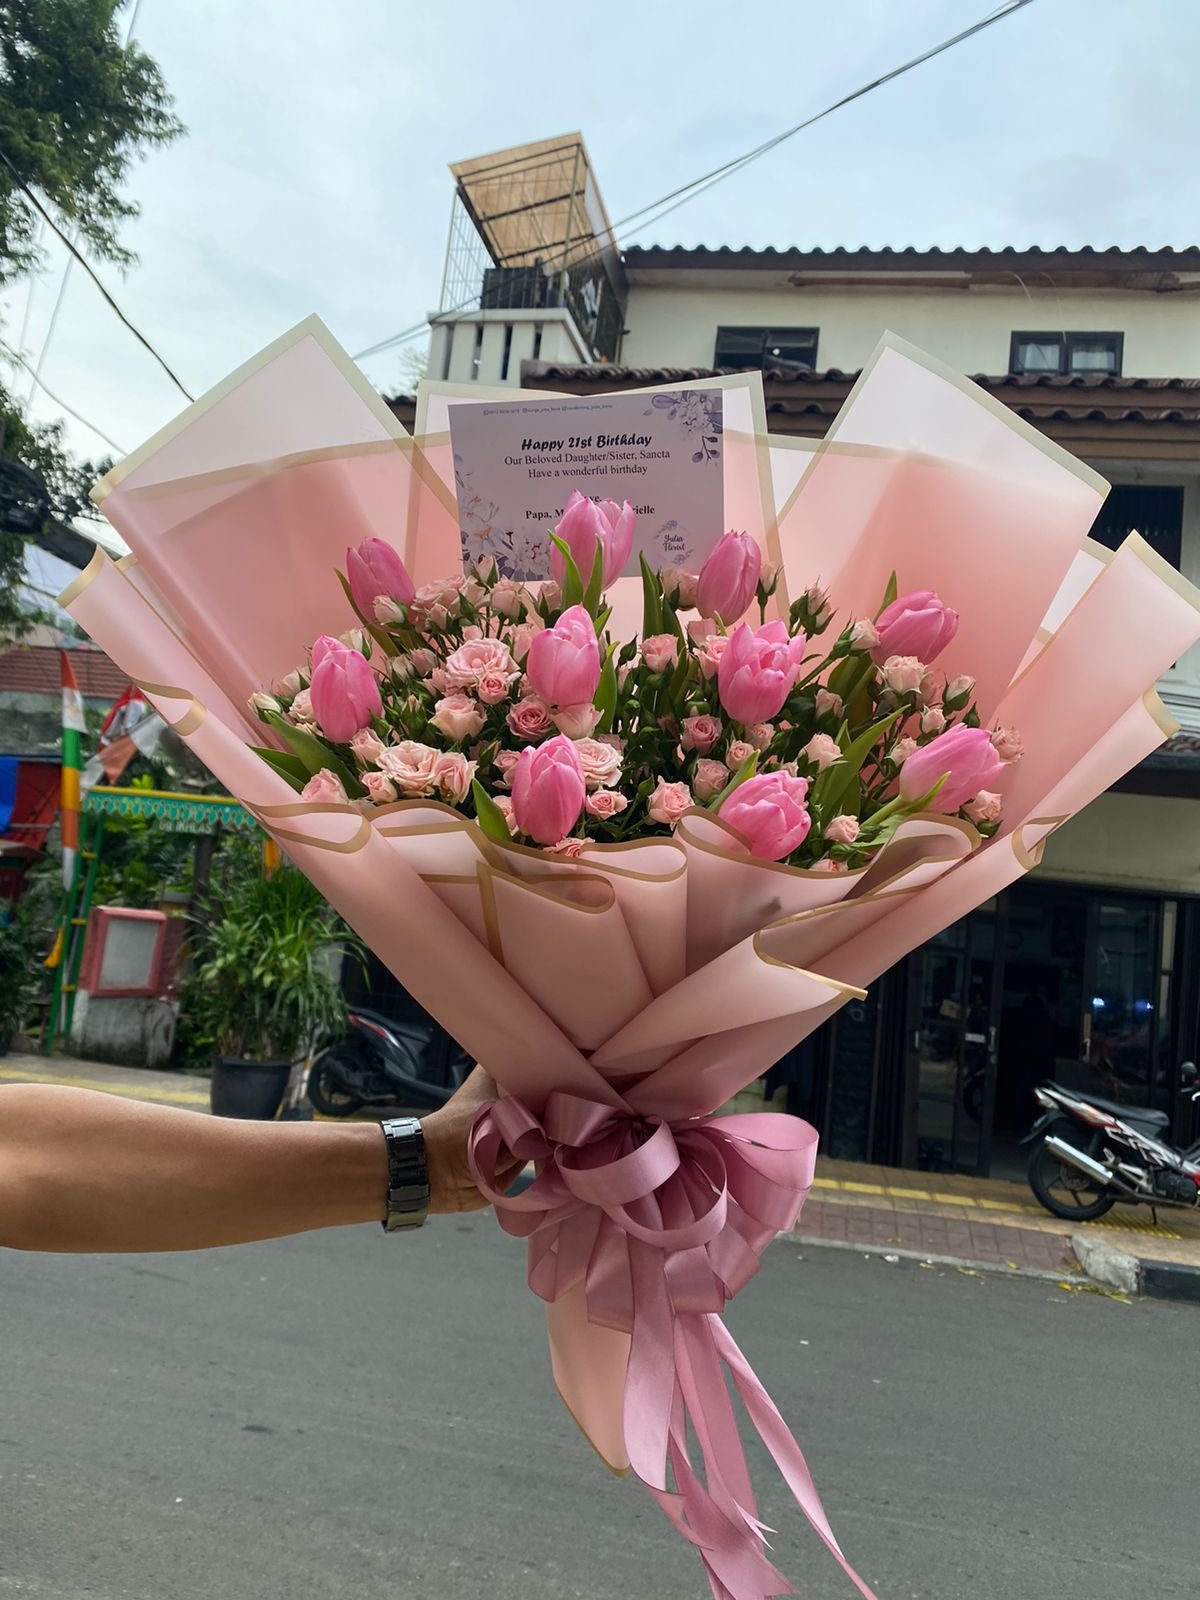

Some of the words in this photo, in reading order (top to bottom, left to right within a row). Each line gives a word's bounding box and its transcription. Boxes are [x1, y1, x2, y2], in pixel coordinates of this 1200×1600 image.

[521, 439, 564, 451] Happy
[568, 436, 592, 449] 21st
[596, 433, 652, 448] Birthday
[504, 456, 522, 465] Our
[525, 453, 562, 464] Beloved
[565, 451, 638, 464] Daughter/Sister,
[639, 450, 671, 459] Sancta
[528, 469, 552, 478] Have
[562, 465, 608, 476] wonderful
[610, 464, 648, 475] birthday
[525, 510, 552, 521] Papa,
